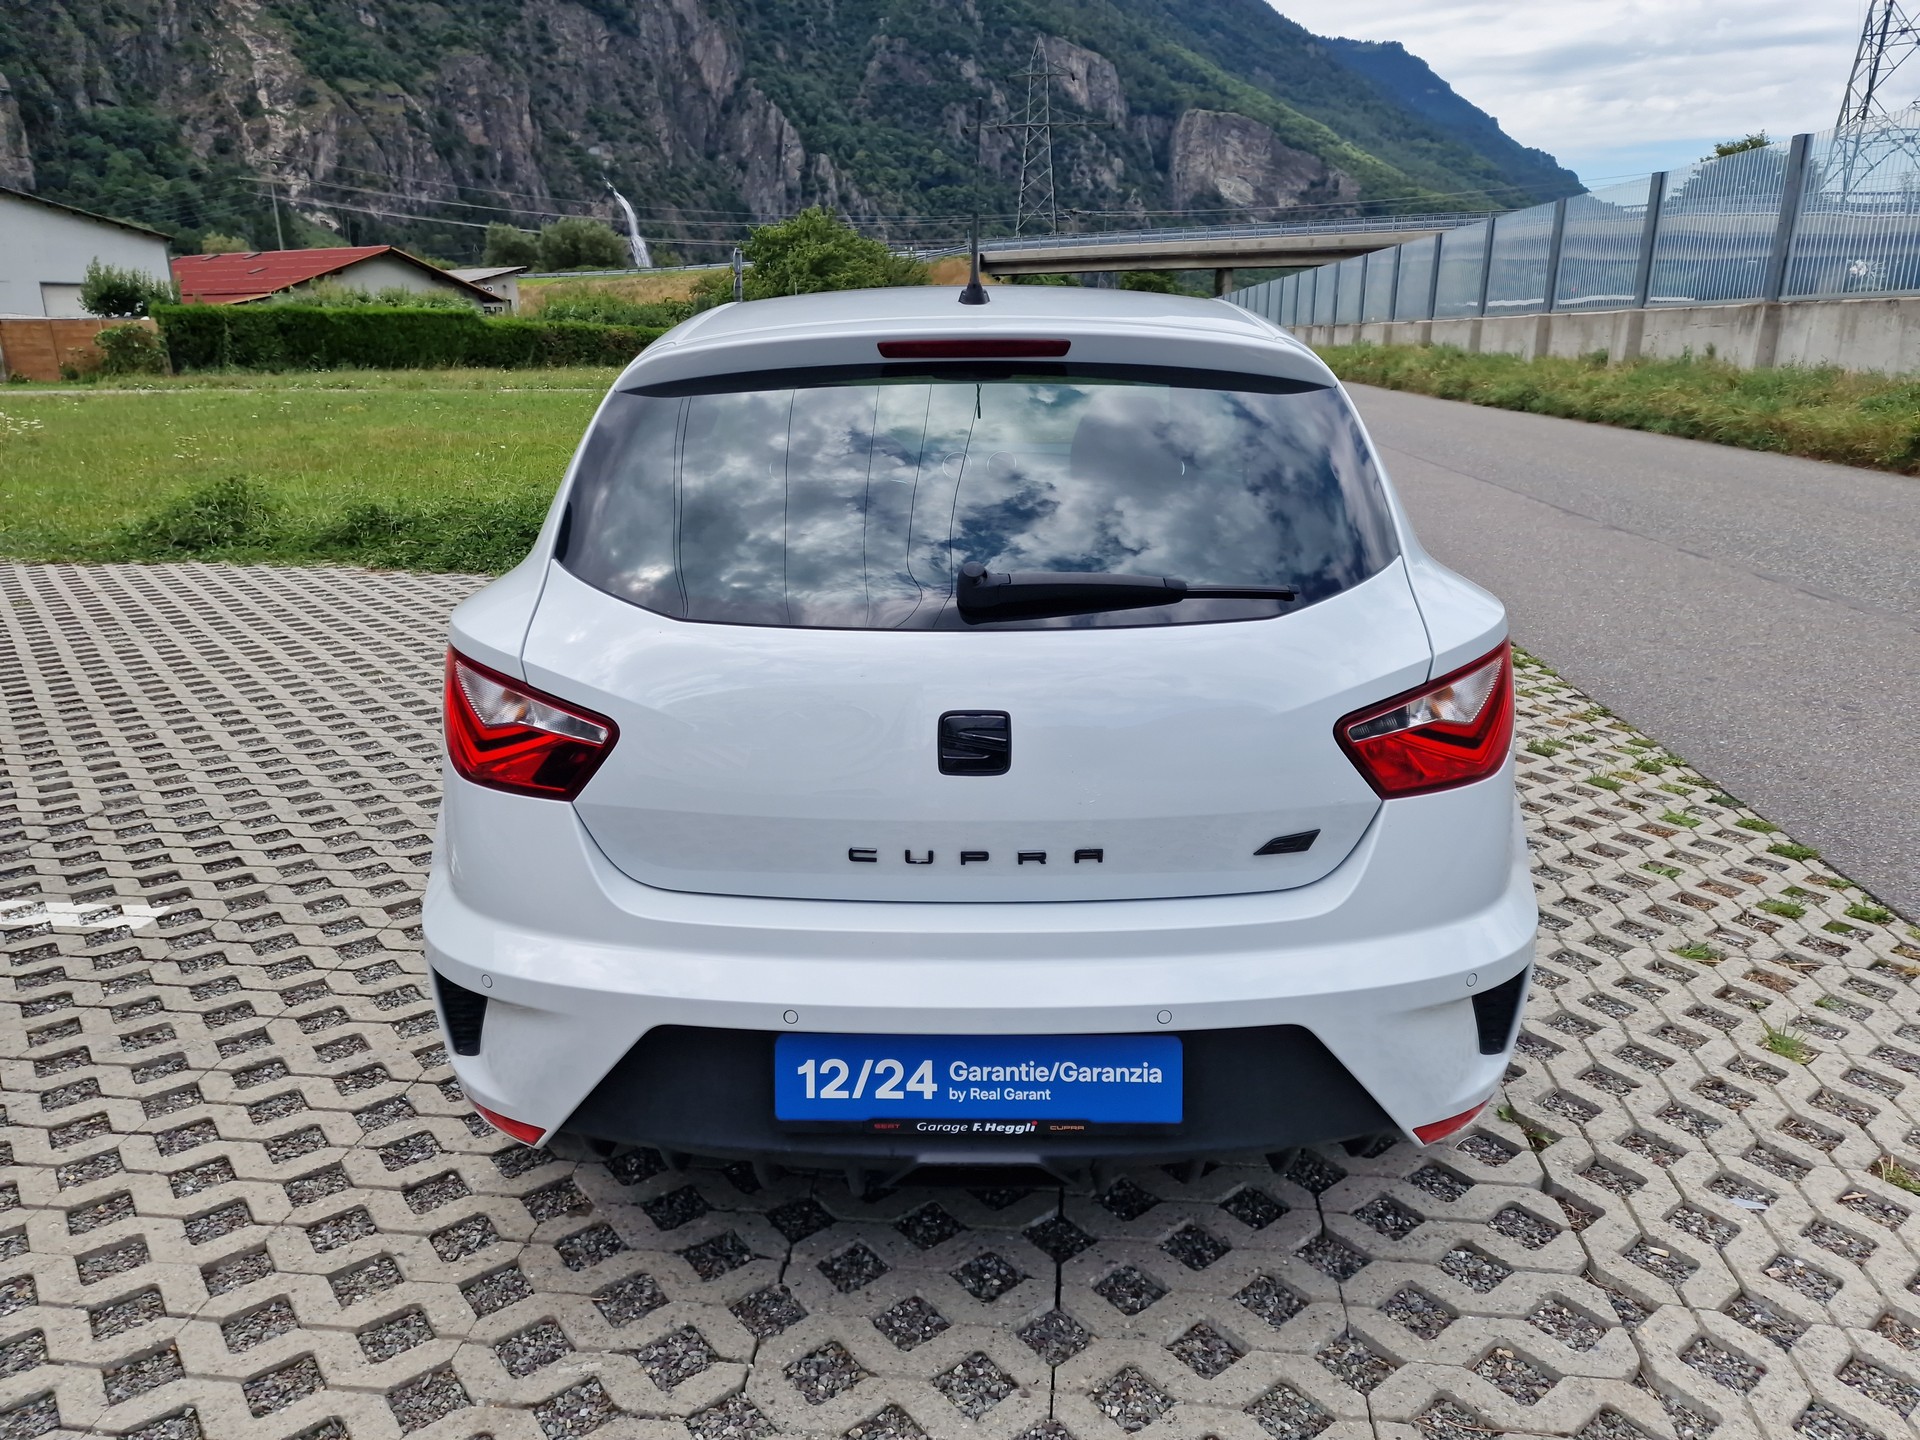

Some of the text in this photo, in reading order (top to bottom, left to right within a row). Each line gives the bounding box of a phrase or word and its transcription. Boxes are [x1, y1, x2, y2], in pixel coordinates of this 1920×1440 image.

[848, 847, 1104, 866] CUPRA
[797, 1059, 937, 1099] 12/24
[949, 1060, 1163, 1084] Garantie/Garanzia
[949, 1087, 1052, 1102] by Real Garant
[916, 1122, 968, 1134] Garage
